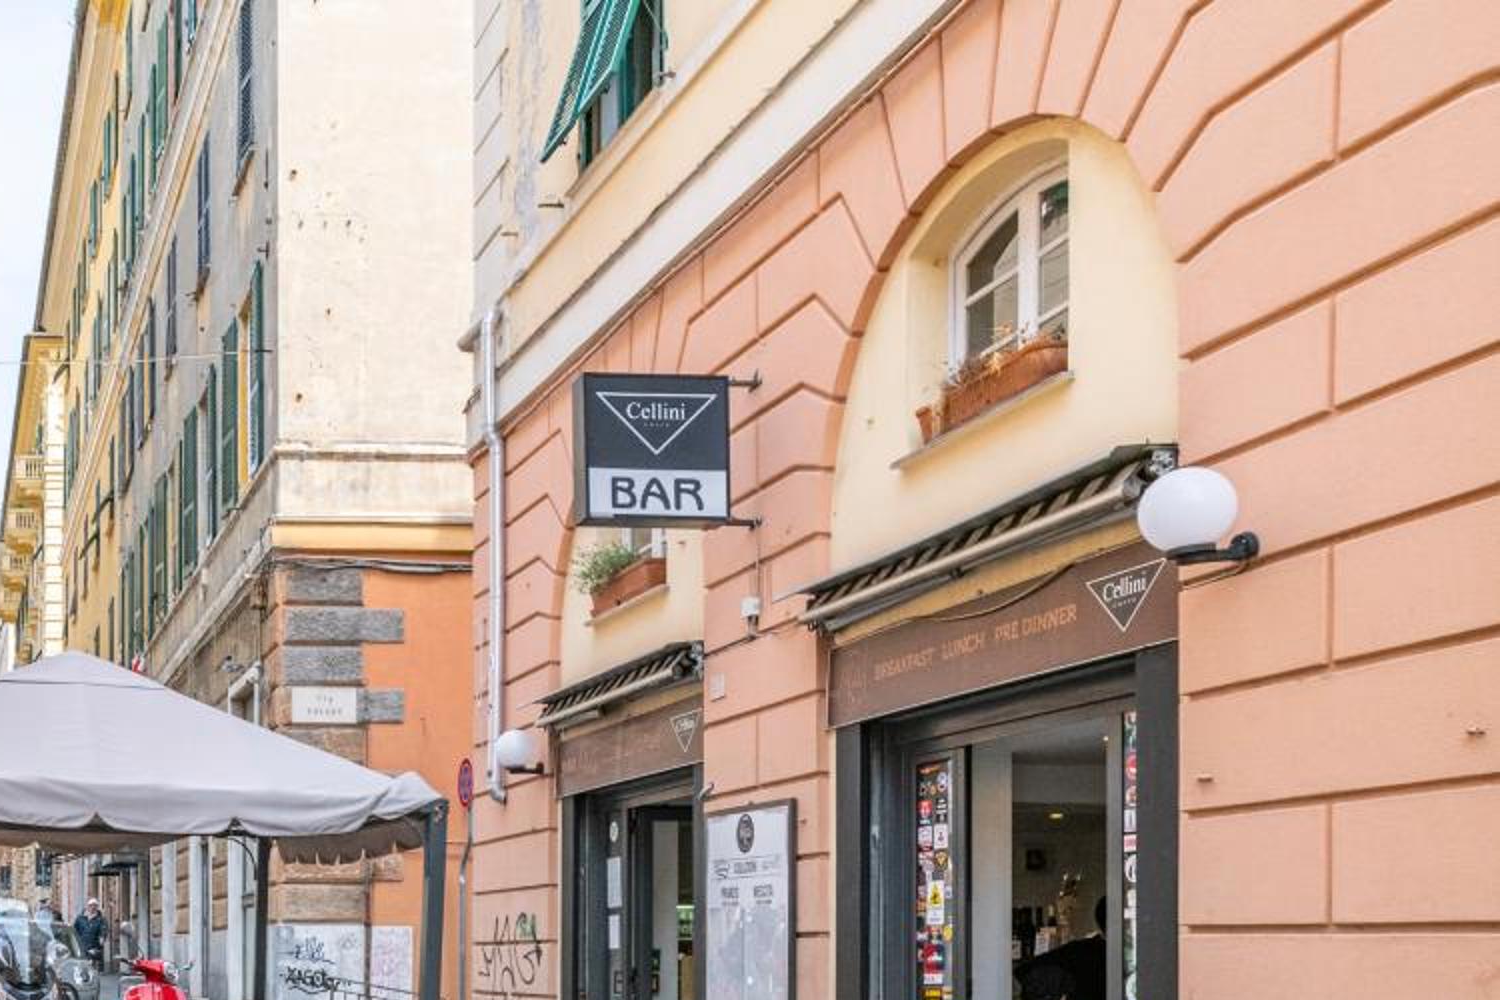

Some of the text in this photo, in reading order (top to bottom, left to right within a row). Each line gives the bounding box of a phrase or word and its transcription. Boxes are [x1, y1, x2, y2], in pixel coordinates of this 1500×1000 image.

[626, 402, 685, 420] Cellini
[611, 477, 704, 511] BAR
[1103, 570, 1146, 602] Cellini
[941, 631, 985, 660] LUNCH
[995, 620, 1018, 642] PRE
[1022, 604, 1077, 638] DINNER
